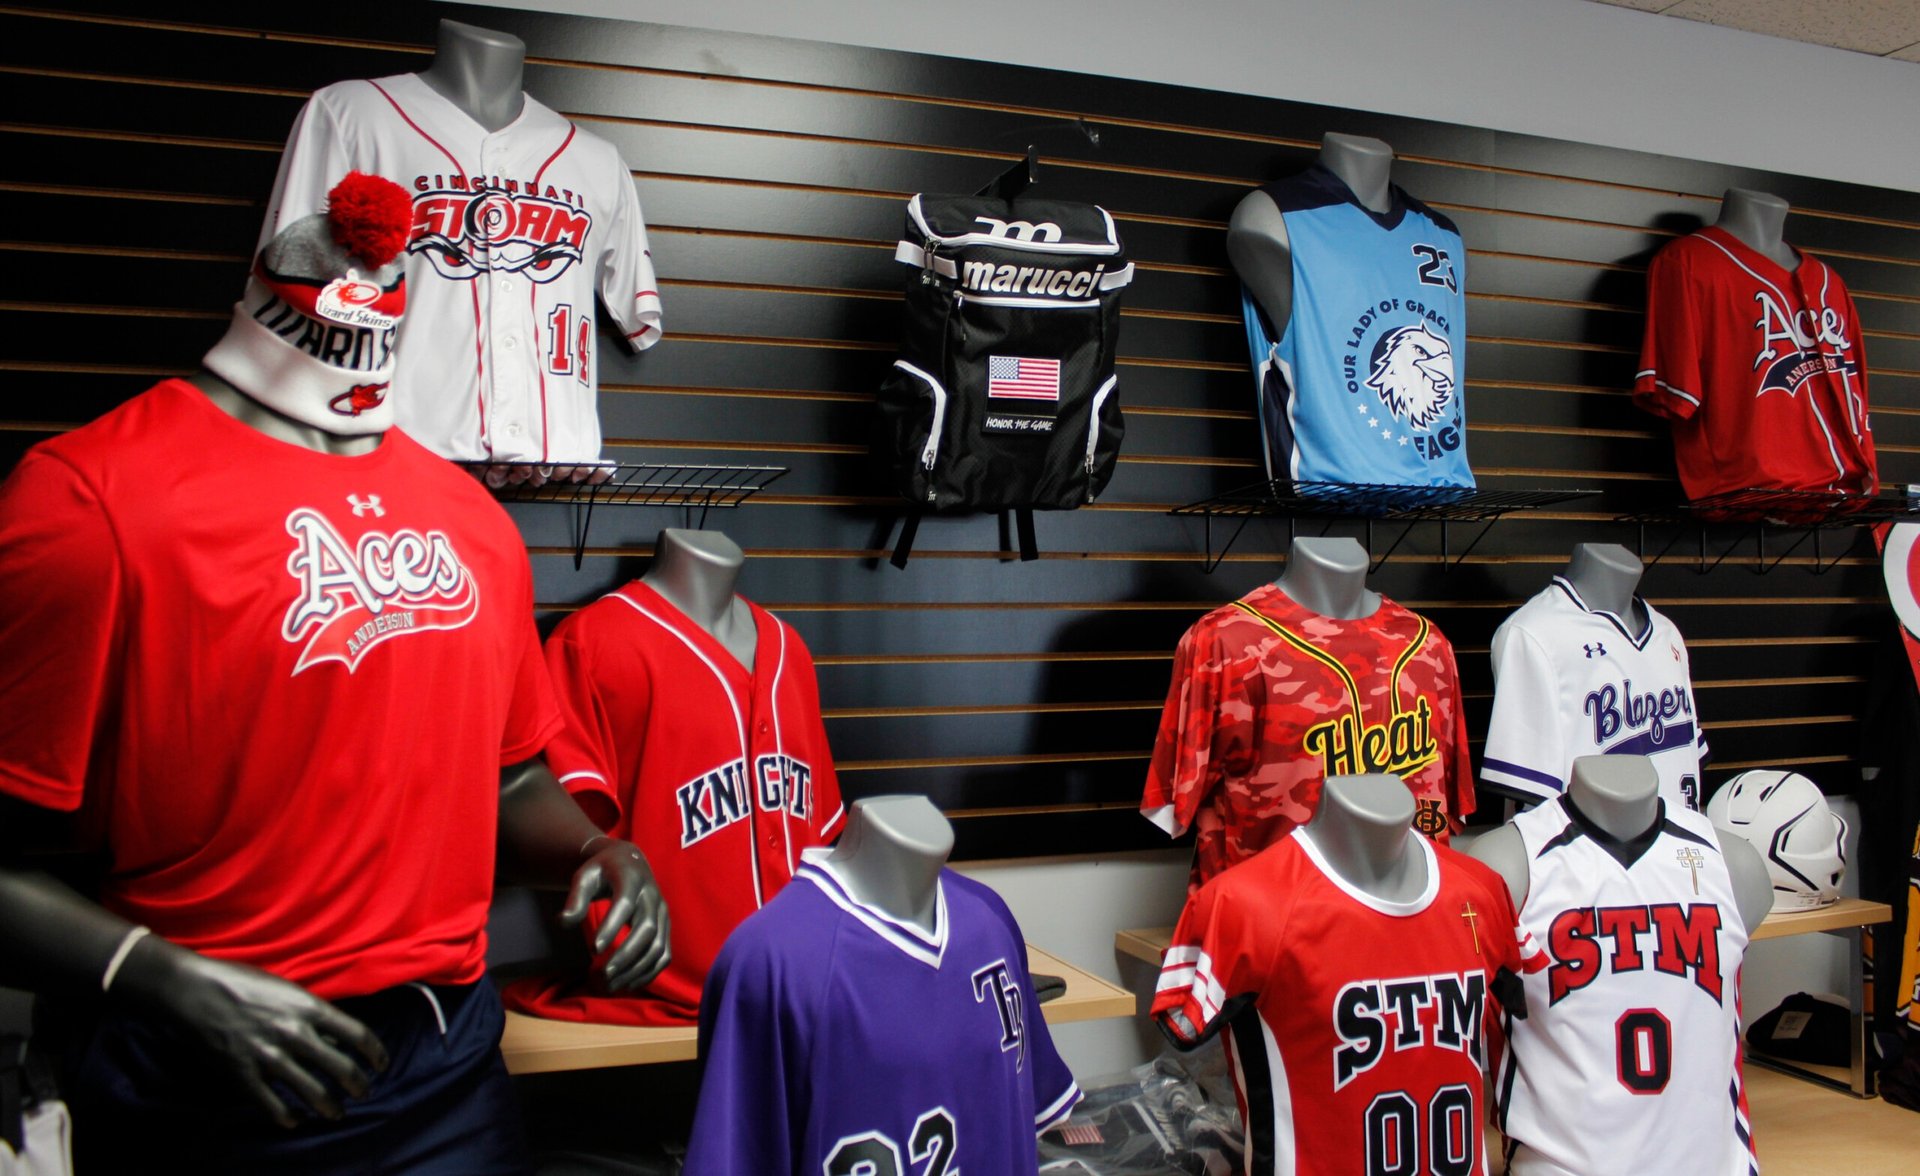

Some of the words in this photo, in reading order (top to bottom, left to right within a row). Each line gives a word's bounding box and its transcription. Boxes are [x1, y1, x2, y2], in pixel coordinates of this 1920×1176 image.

[409, 193, 592, 252] STORM
[414, 175, 584, 208] CINCINNATI
[962, 260, 1105, 298] marucci
[1379, 298, 1400, 314] OF
[317, 299, 354, 322] Lizard
[353, 309, 393, 328] Skins
[547, 303, 592, 388] 14
[1346, 306, 1378, 349] LADY
[1753, 290, 1851, 370] Ace
[1343, 354, 1359, 394] OUR
[985, 416, 1013, 430] HONOR
[1014, 419, 1031, 430] THE
[1030, 420, 1054, 432] GAME
[282, 507, 466, 643] Aces
[346, 612, 415, 656] ANDERSON
[1302, 695, 1439, 778] Heat
[1584, 678, 1692, 745] Blazer
[676, 753, 813, 850] KNIGHT
[1549, 902, 1723, 1009] STM
[1333, 968, 1488, 1093] STM
[1614, 1006, 1672, 1096] 0
[1363, 1082, 1474, 1176] 00
